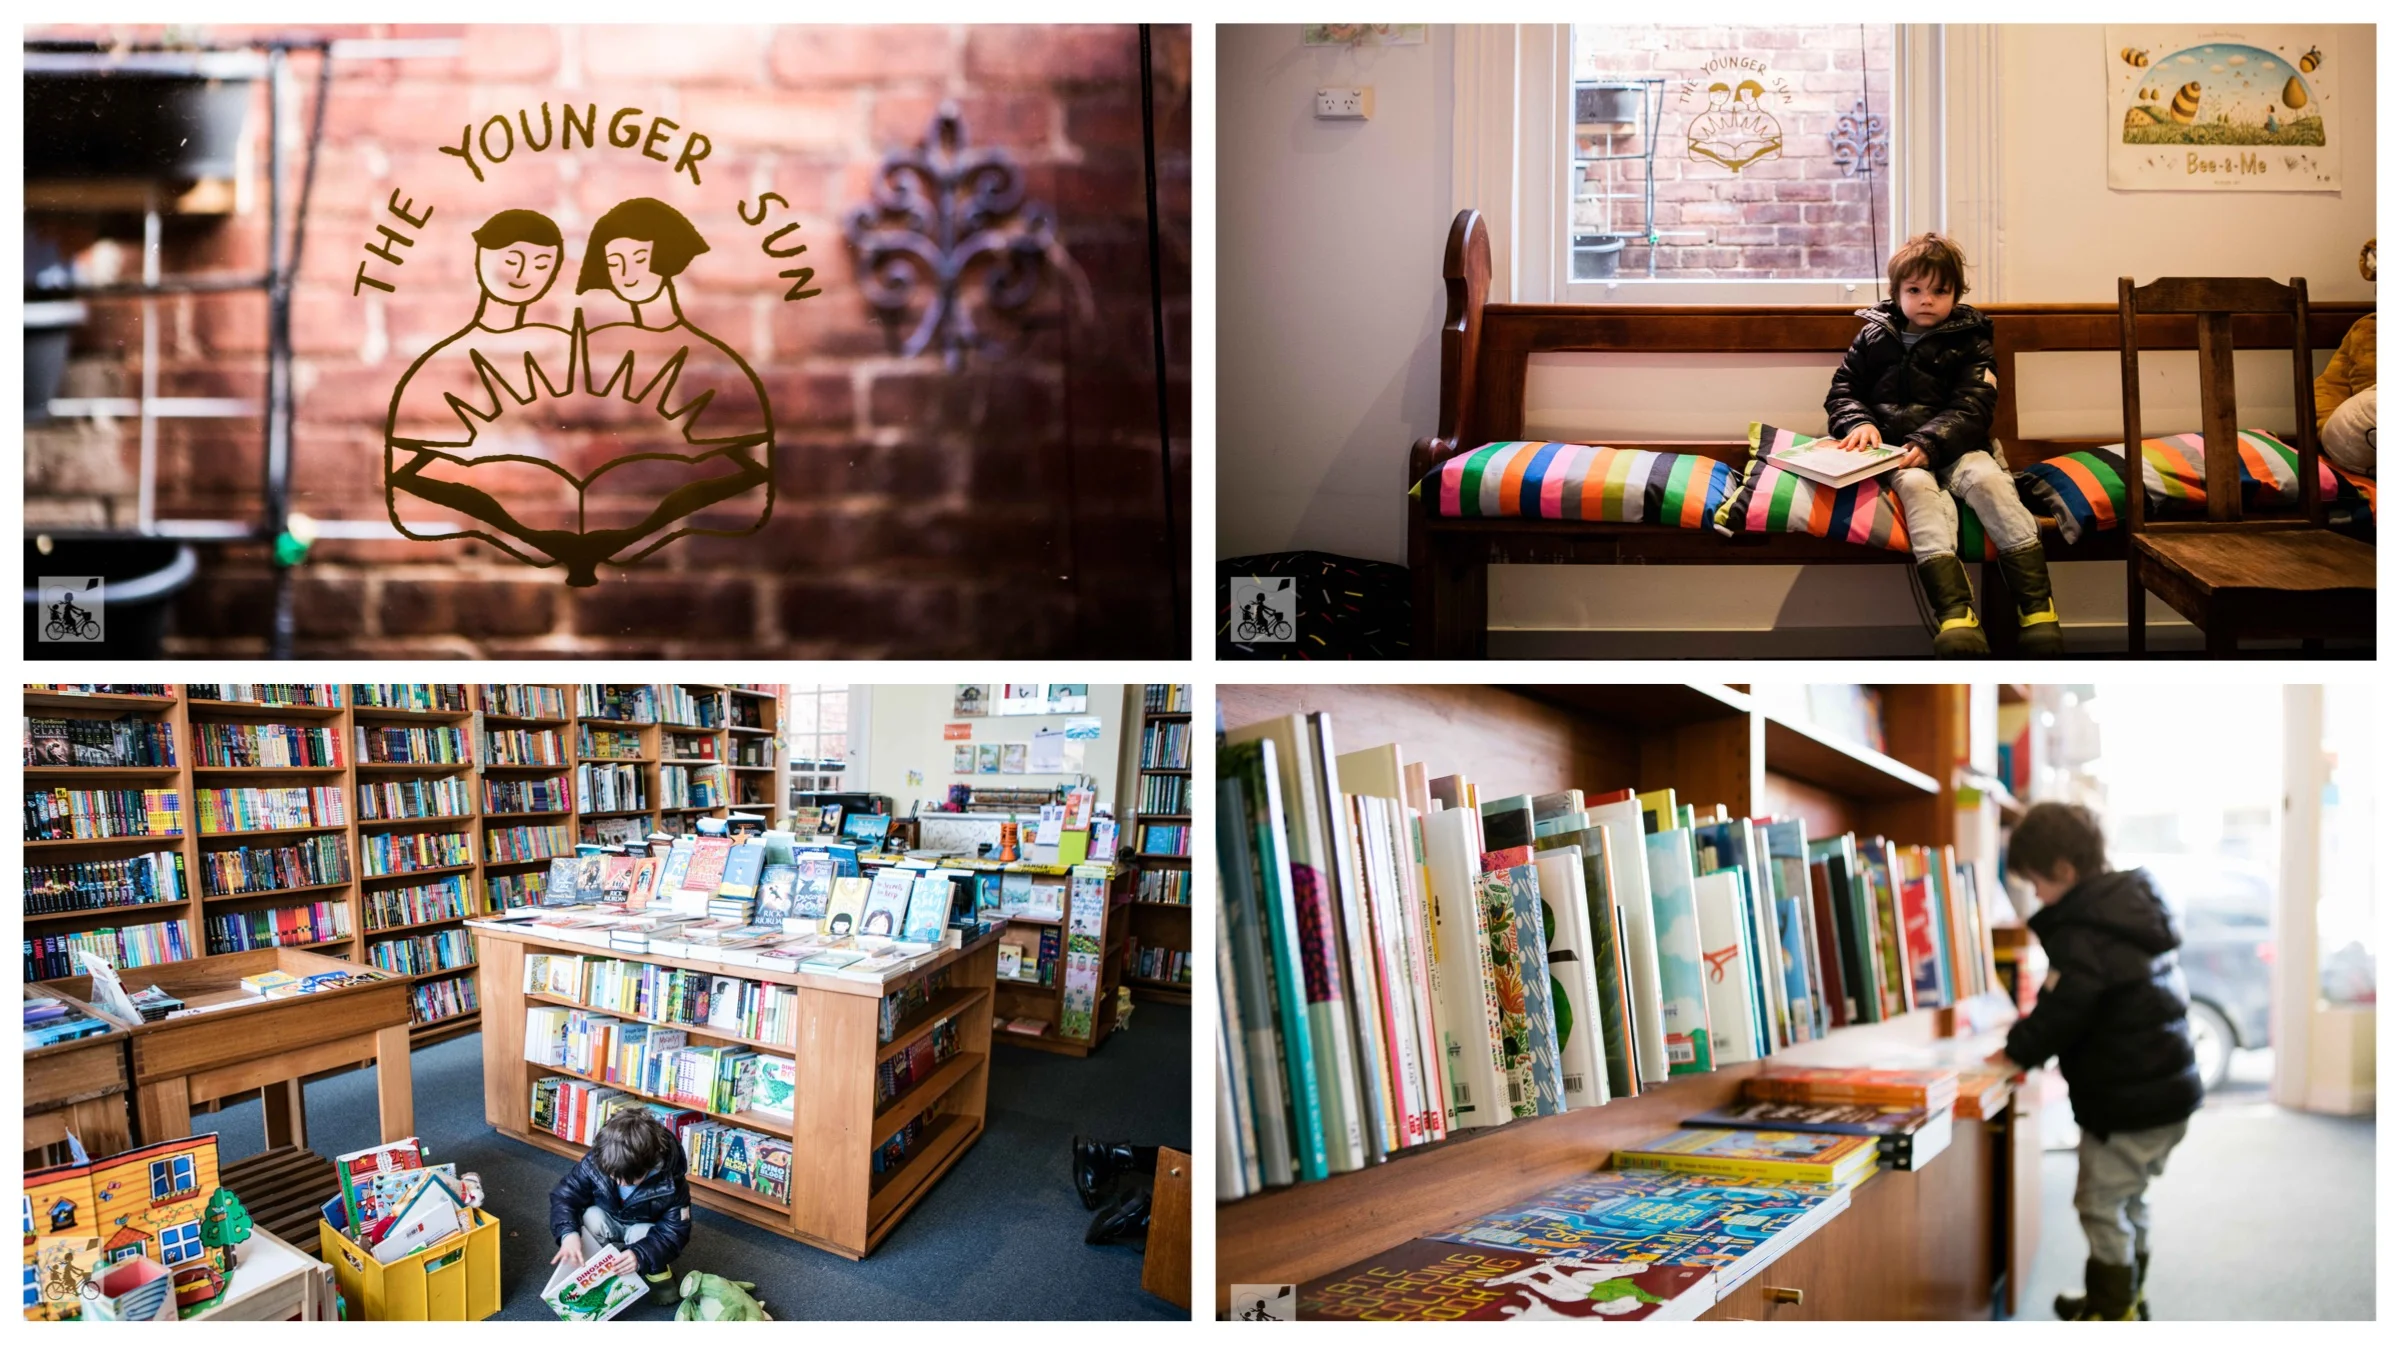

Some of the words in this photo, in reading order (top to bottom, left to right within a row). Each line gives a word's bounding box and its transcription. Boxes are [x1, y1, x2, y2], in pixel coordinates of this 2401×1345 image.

[1679, 77, 1699, 105] THE
[1700, 56, 1767, 76] YOUNGER
[1772, 77, 1793, 105] SUN
[353, 187, 434, 297] THE
[439, 101, 712, 185] YOUNGER
[737, 191, 823, 302] SUN
[33, 728, 68, 736] CLARE
[175, 855, 184, 871] GONE
[754, 916, 782, 925] RIORDA
[763, 910, 781, 918] RICK
[33, 938, 45, 960] PLAGUE
[45, 936, 55, 954] FEAR
[1497, 1043, 1506, 1074] JAMES
[760, 1162, 785, 1174] DINO
[760, 1168, 785, 1181] BLOCK
[1671, 1209, 1704, 1221] Pad
[576, 1253, 614, 1282] DINOSAUR
[1318, 1253, 1485, 1316] BOARDING
[1401, 1288, 1505, 1321] OOK
